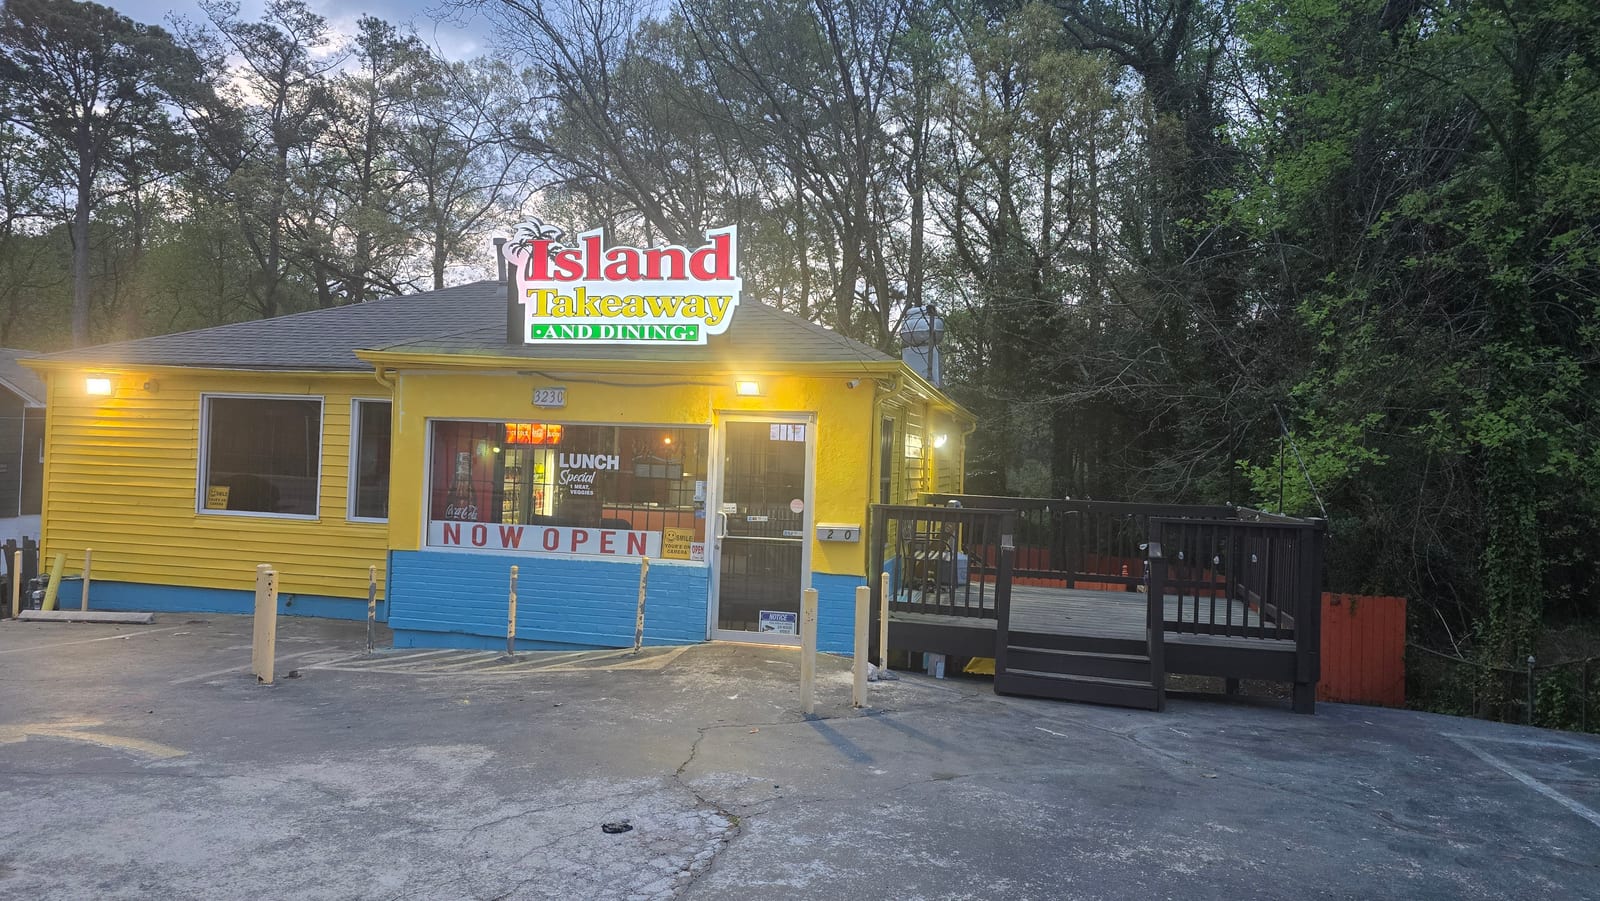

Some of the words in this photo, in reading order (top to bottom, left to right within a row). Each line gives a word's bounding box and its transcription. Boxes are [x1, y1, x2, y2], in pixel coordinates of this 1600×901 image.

[527, 233, 735, 281] Island
[526, 286, 733, 326] Takeaway
[543, 325, 593, 339] AND
[600, 325, 688, 340] DINING
[534, 390, 563, 403] 3230
[559, 453, 620, 470] LUNCH
[558, 469, 596, 485] Special
[443, 522, 524, 549] NOW
[542, 527, 648, 556] OPEN
[692, 545, 704, 554] OPEN
[768, 613, 787, 622] NOTICE
